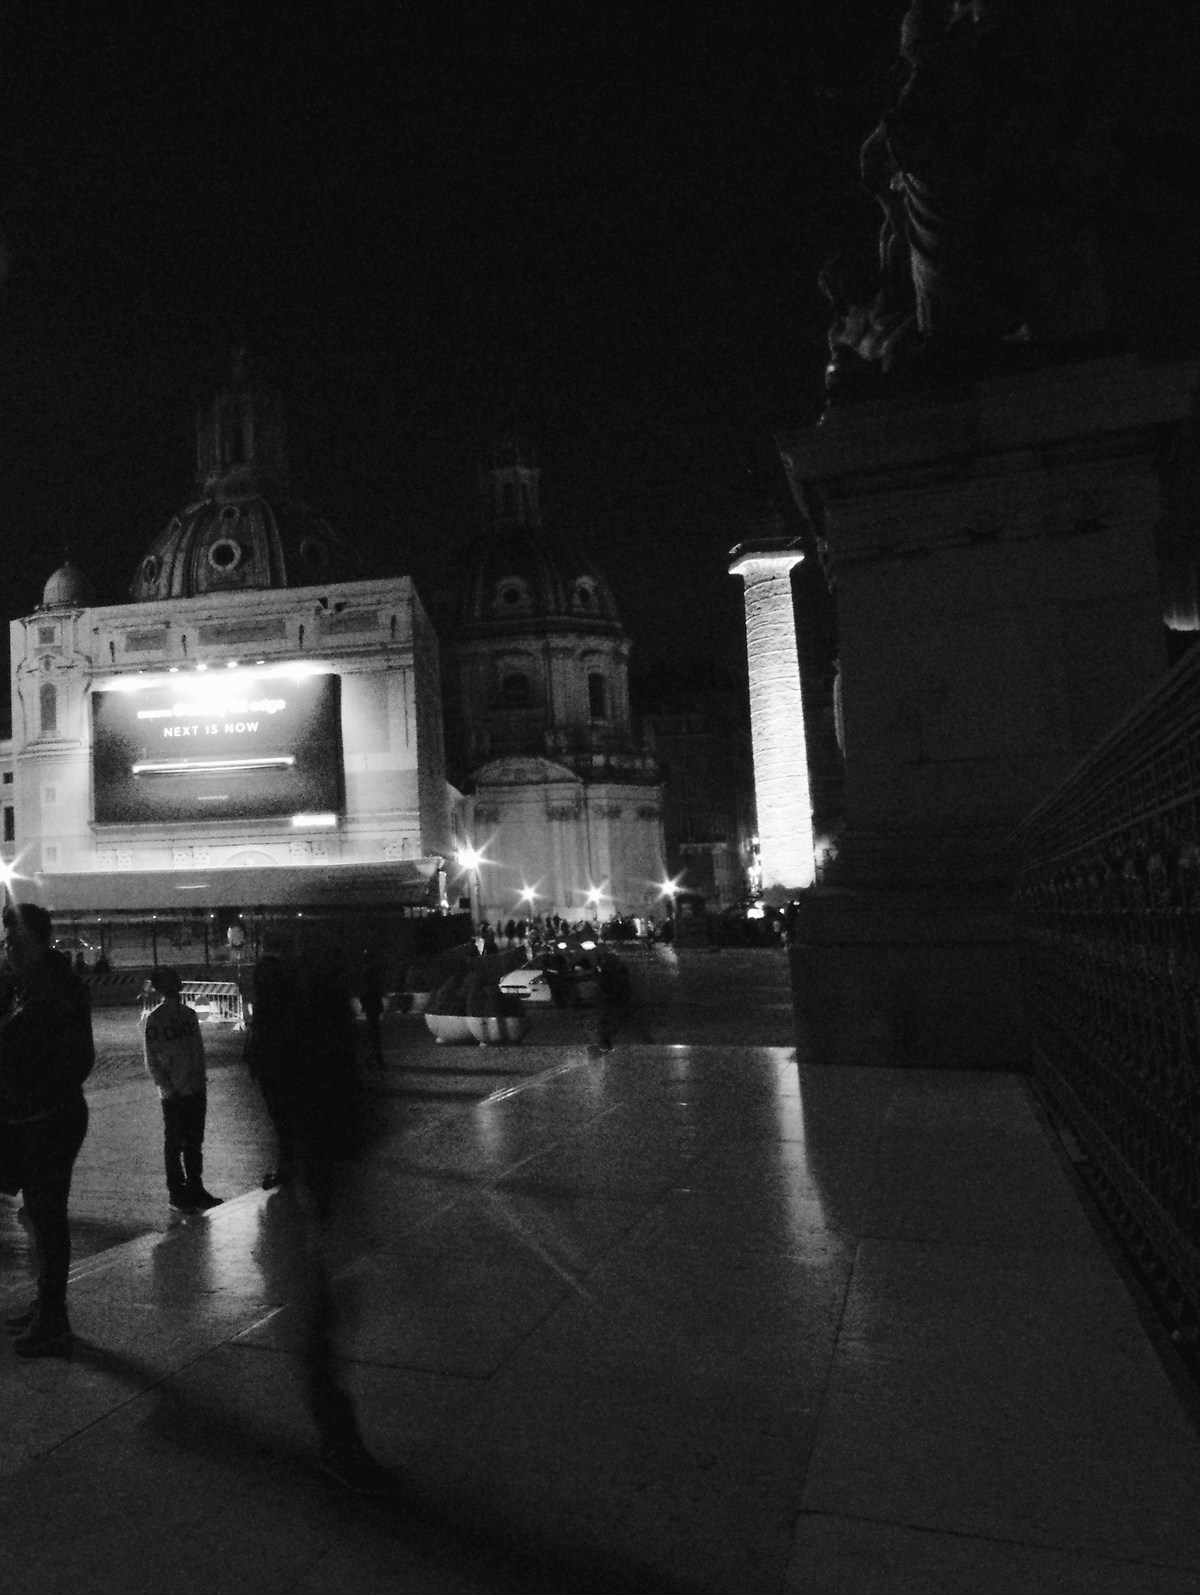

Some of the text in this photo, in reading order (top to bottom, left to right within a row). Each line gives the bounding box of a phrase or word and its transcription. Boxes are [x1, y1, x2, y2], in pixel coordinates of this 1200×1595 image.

[163, 721, 260, 738] NEXT IS NOW
